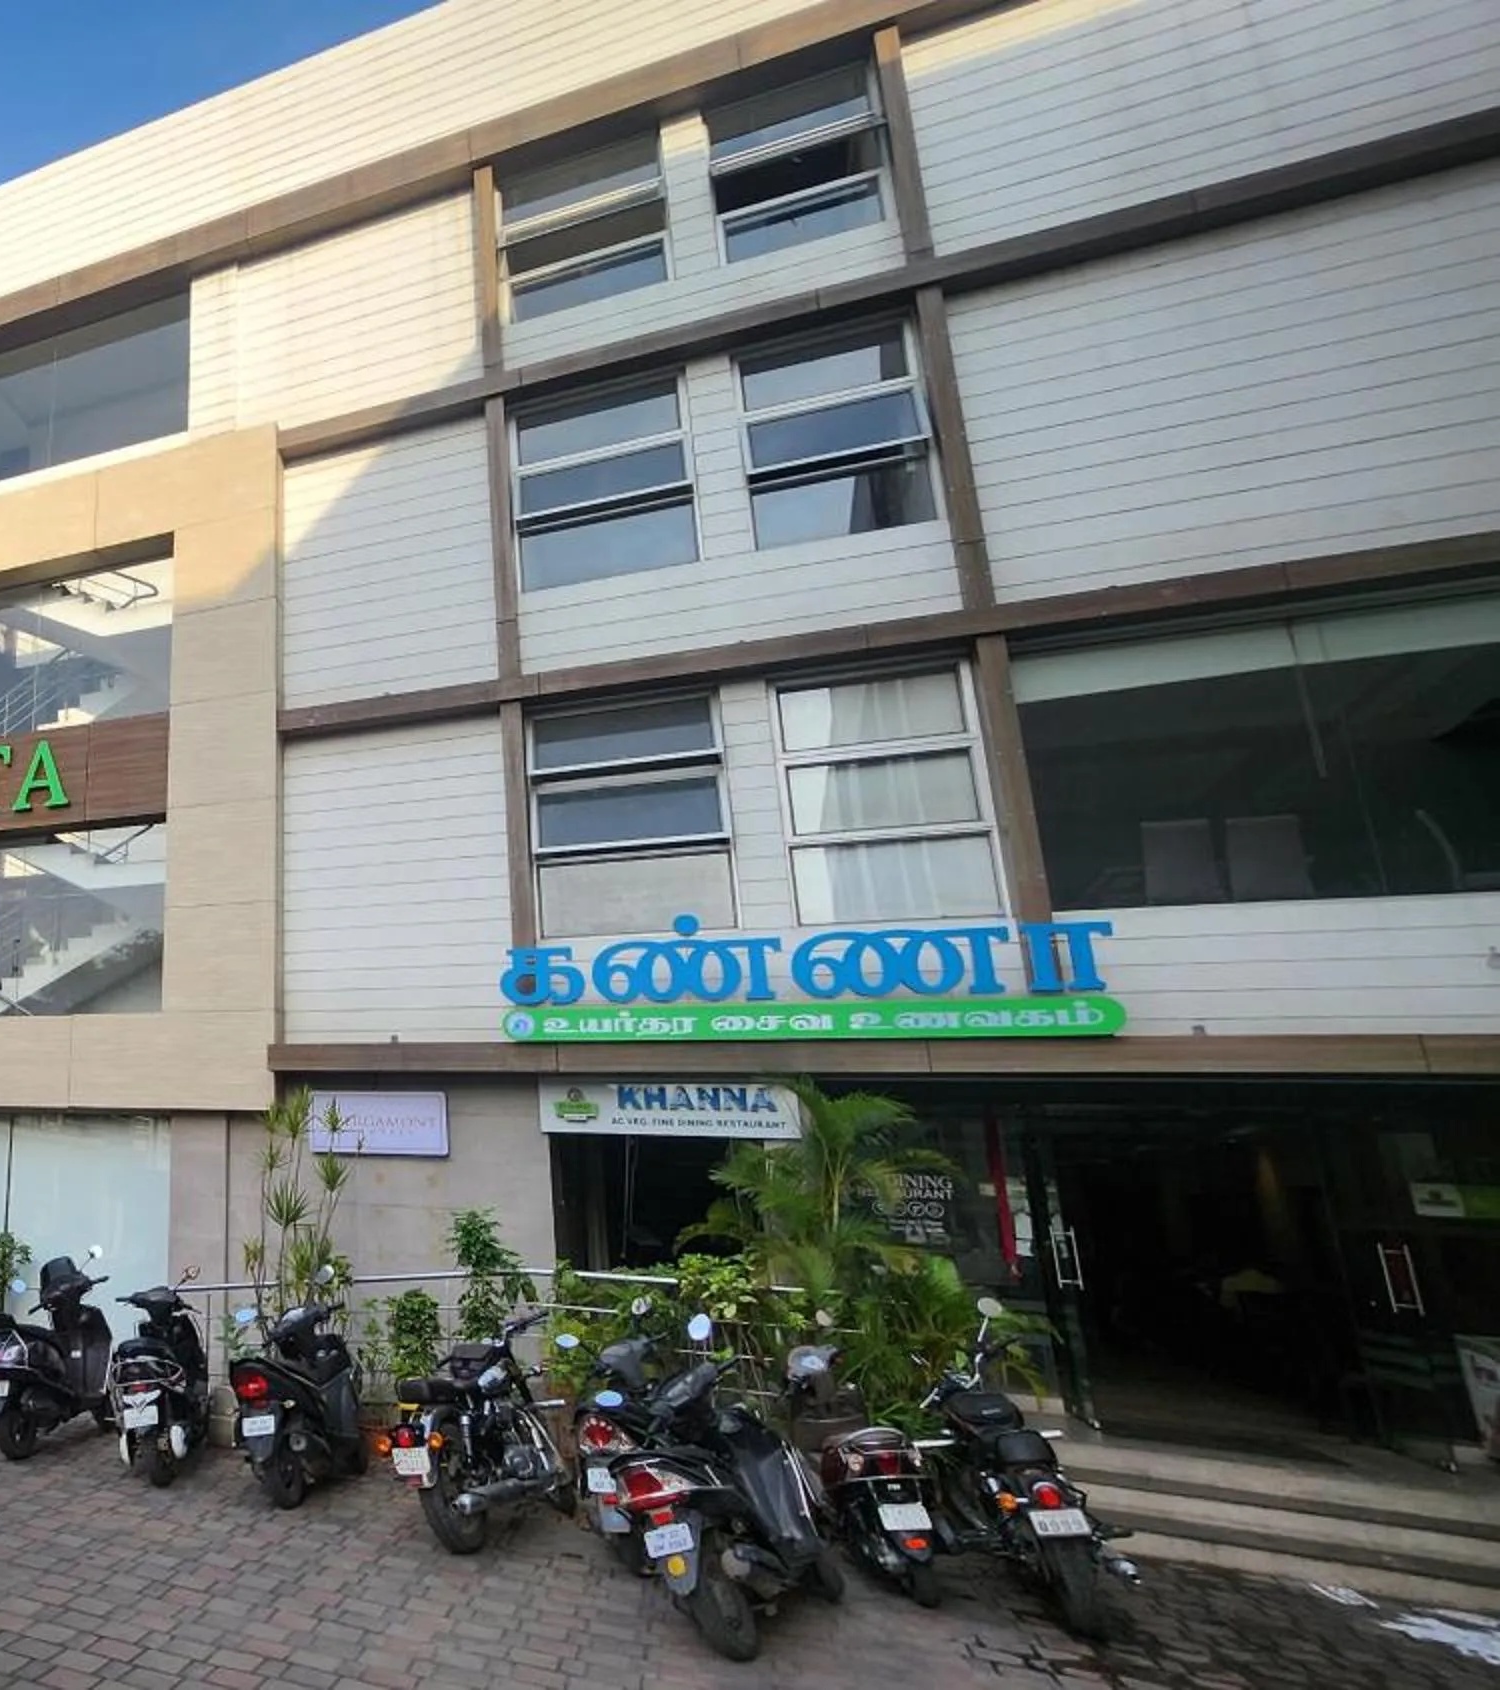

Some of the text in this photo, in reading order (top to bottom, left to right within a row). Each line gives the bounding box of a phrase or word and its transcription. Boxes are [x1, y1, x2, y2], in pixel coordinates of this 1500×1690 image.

[543, 1010, 699, 1036] உயர்தர
[710, 1013, 834, 1032] சைவ
[617, 1085, 779, 1113] KHANNA
[716, 1118, 787, 1129] RESTAURANT
